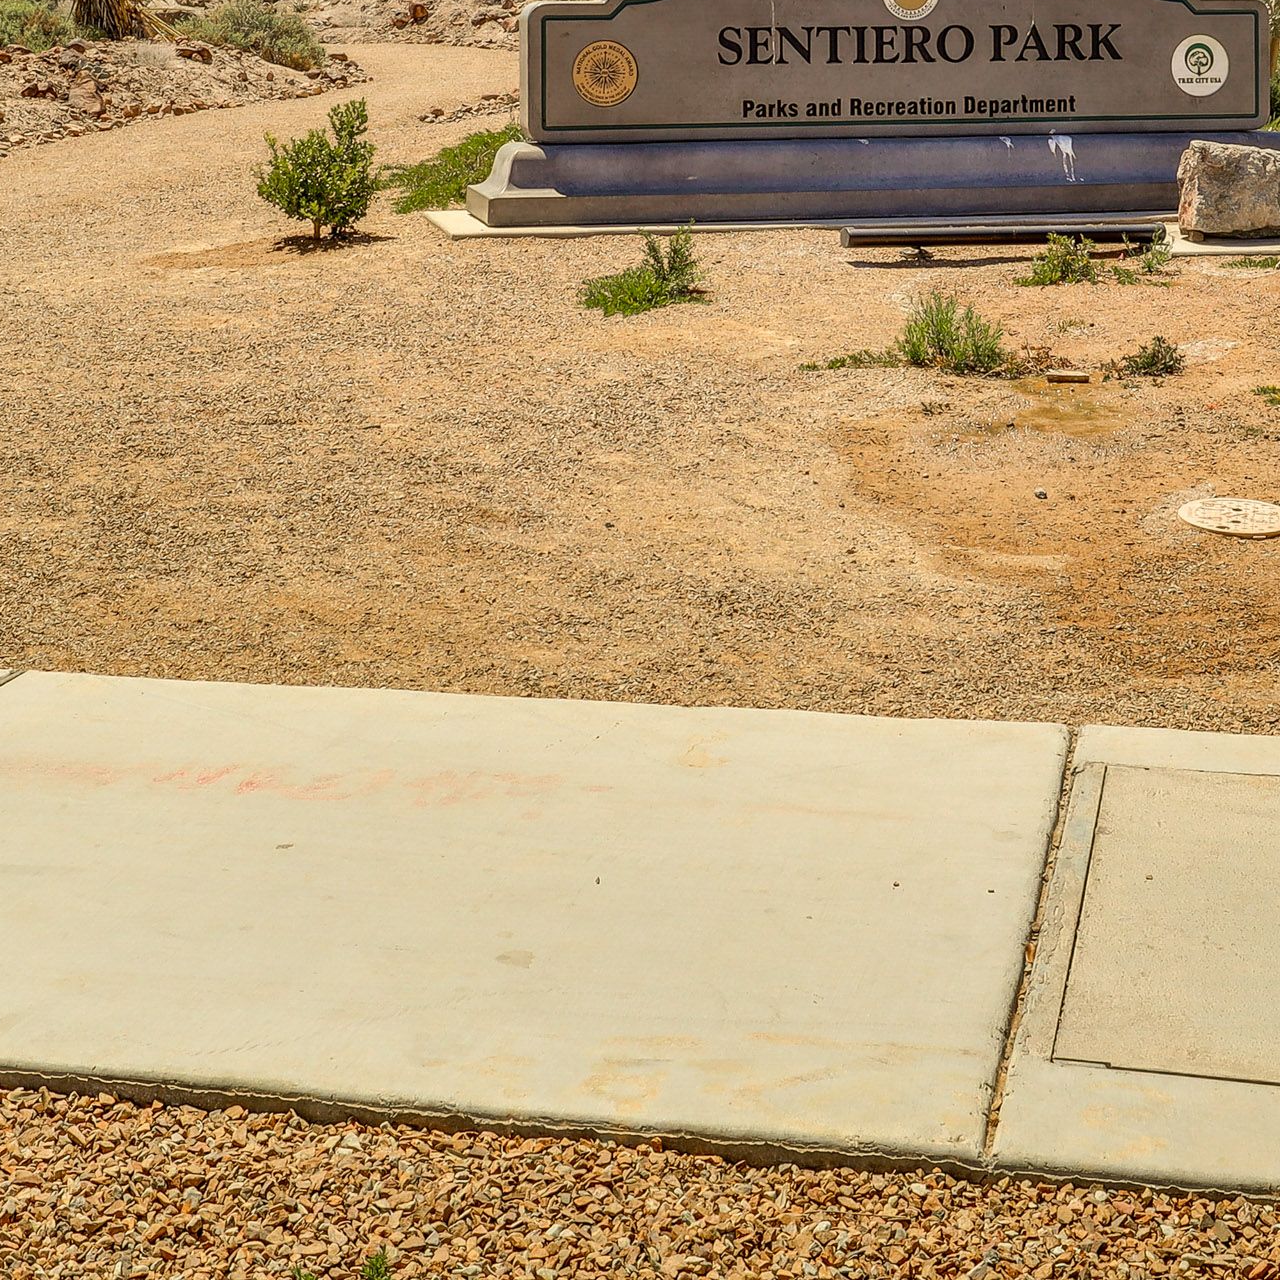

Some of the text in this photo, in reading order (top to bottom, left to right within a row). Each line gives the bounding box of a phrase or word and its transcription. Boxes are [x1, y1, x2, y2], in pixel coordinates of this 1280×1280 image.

[576, 44, 634, 77] NATIONAL GOLD MEDAL AWARD
[717, 23, 1124, 66] SENTIERO PARK
[742, 94, 1076, 118] Parks and Recreation Department
